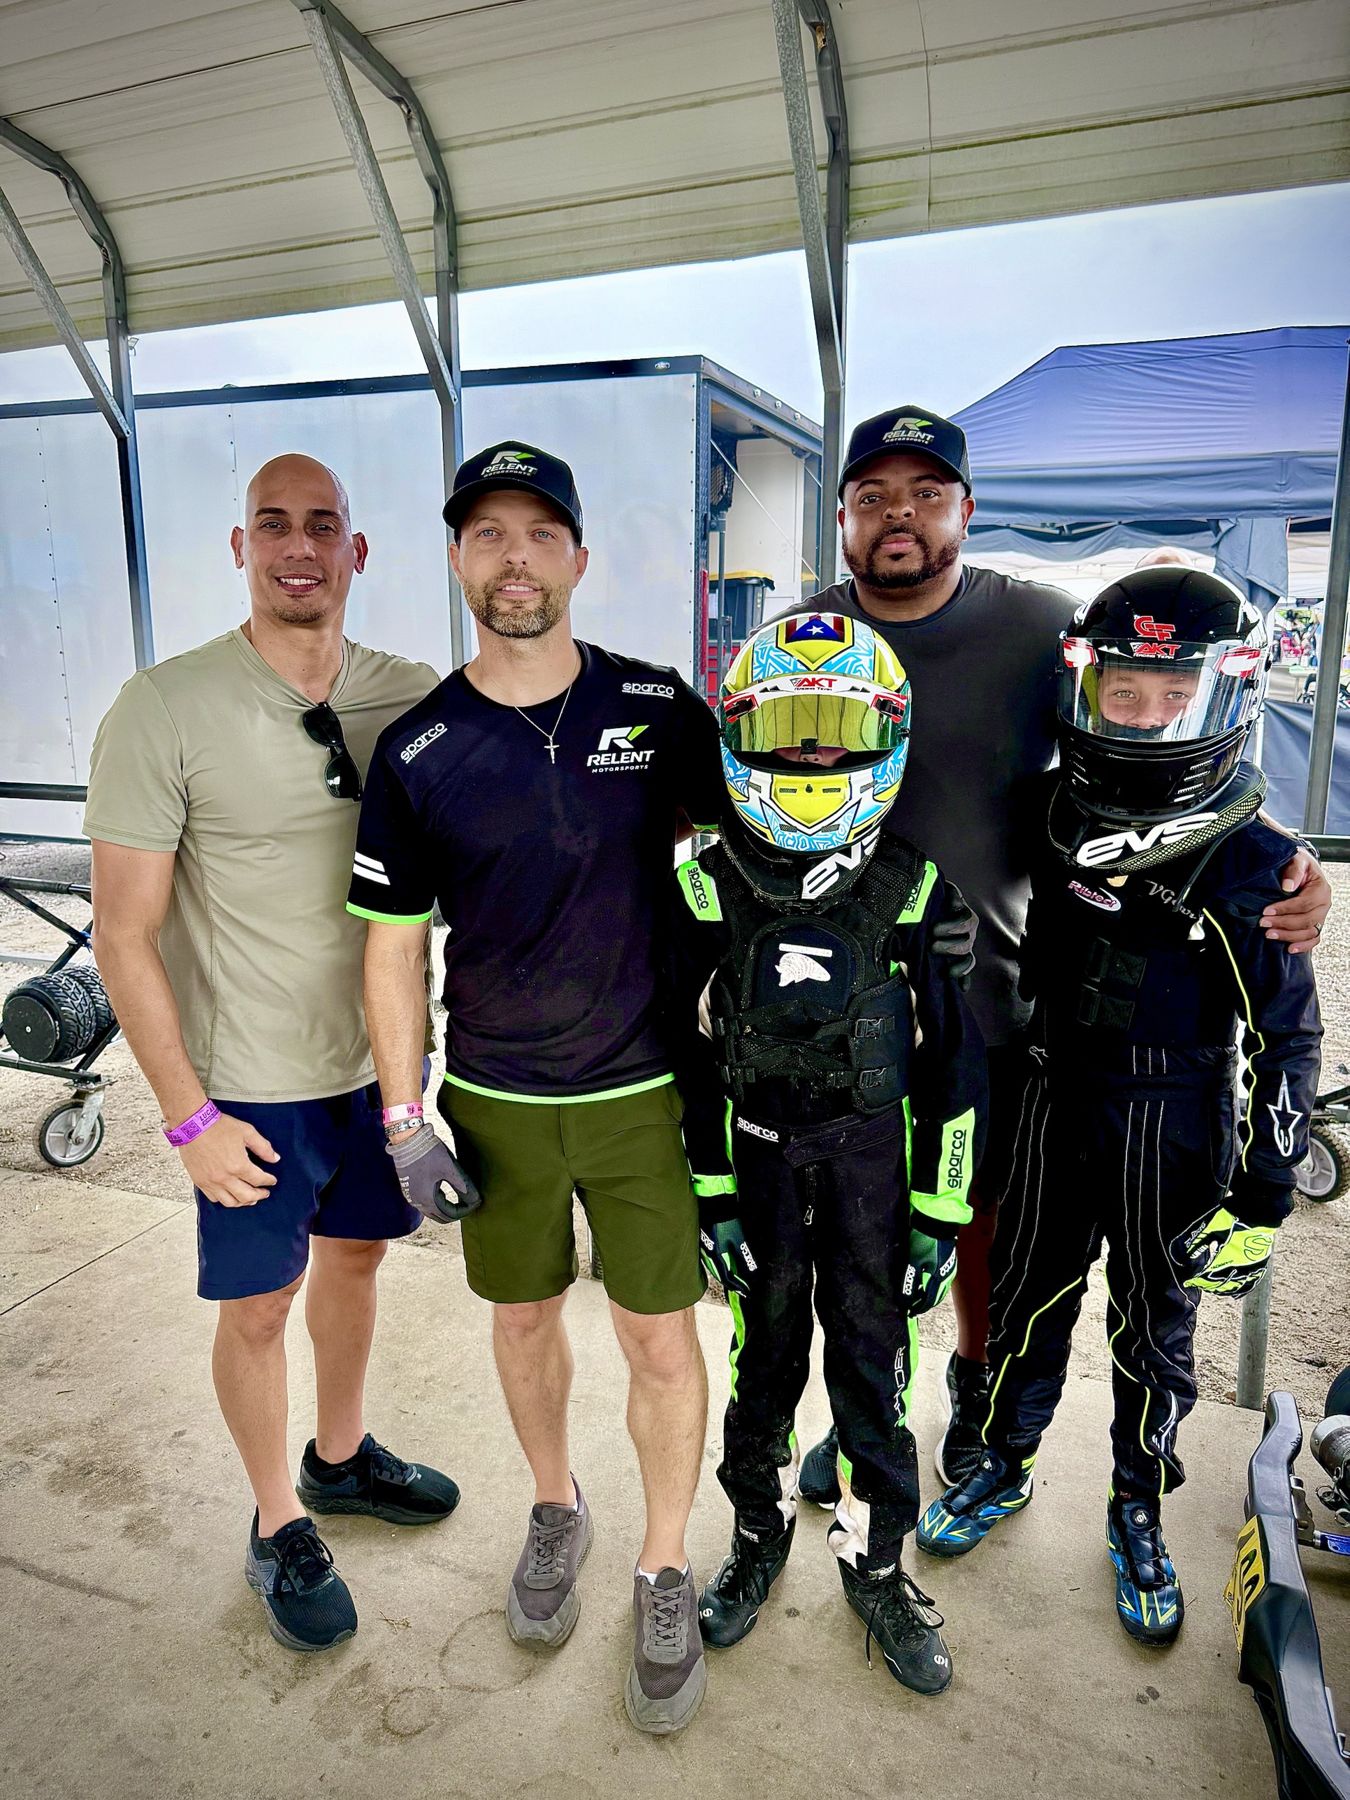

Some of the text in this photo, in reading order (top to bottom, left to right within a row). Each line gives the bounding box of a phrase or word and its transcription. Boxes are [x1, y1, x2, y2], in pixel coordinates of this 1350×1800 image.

[882, 430, 935, 441] RELENT
[481, 463, 538, 476] RELENT
[1135, 642, 1182, 656] AKT
[796, 677, 838, 687] AKT
[621, 682, 675, 700] sparco
[400, 723, 448, 764] sparco
[586, 750, 655, 767] RELENT
[591, 764, 649, 774] MOTORSPORTS
[687, 867, 710, 911] sparco
[737, 1116, 779, 1143] sparco
[947, 1129, 967, 1189] sparco
